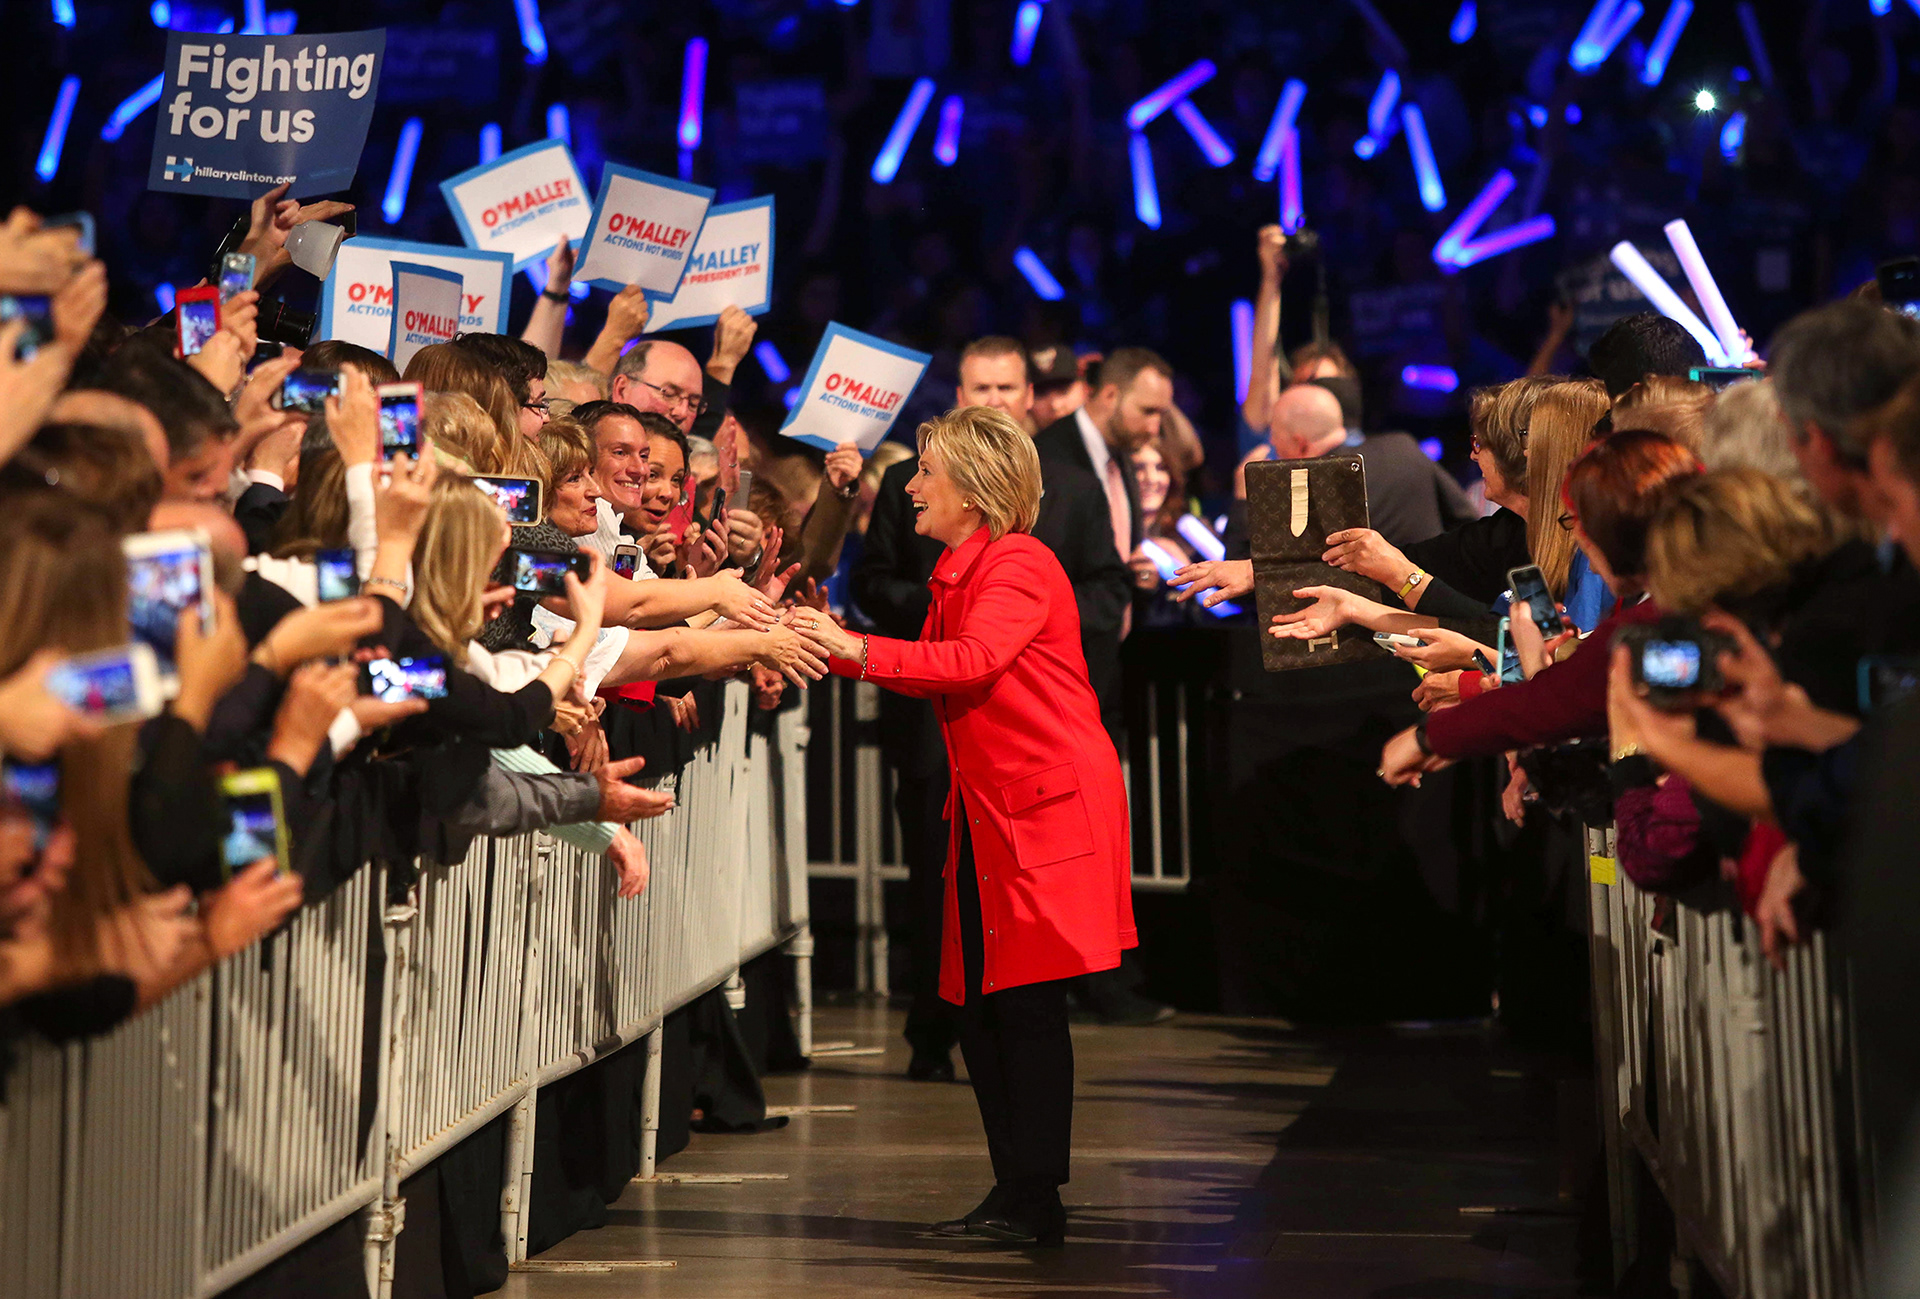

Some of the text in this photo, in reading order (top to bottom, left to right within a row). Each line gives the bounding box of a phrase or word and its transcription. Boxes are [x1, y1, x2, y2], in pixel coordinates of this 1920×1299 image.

[177, 43, 376, 104] Fighting
[168, 91, 316, 143] for us
[481, 177, 573, 228] O'MALLEY
[604, 233, 644, 251] ACTIONS
[645, 244, 661, 254] NOT
[608, 213, 692, 248] O'MALLEY
[686, 243, 760, 273] MALLEY
[347, 303, 393, 318] ACTION
[819, 393, 859, 412] ACTIONS
[860, 406, 875, 417] NOT
[825, 373, 903, 411] O'MALLEY
